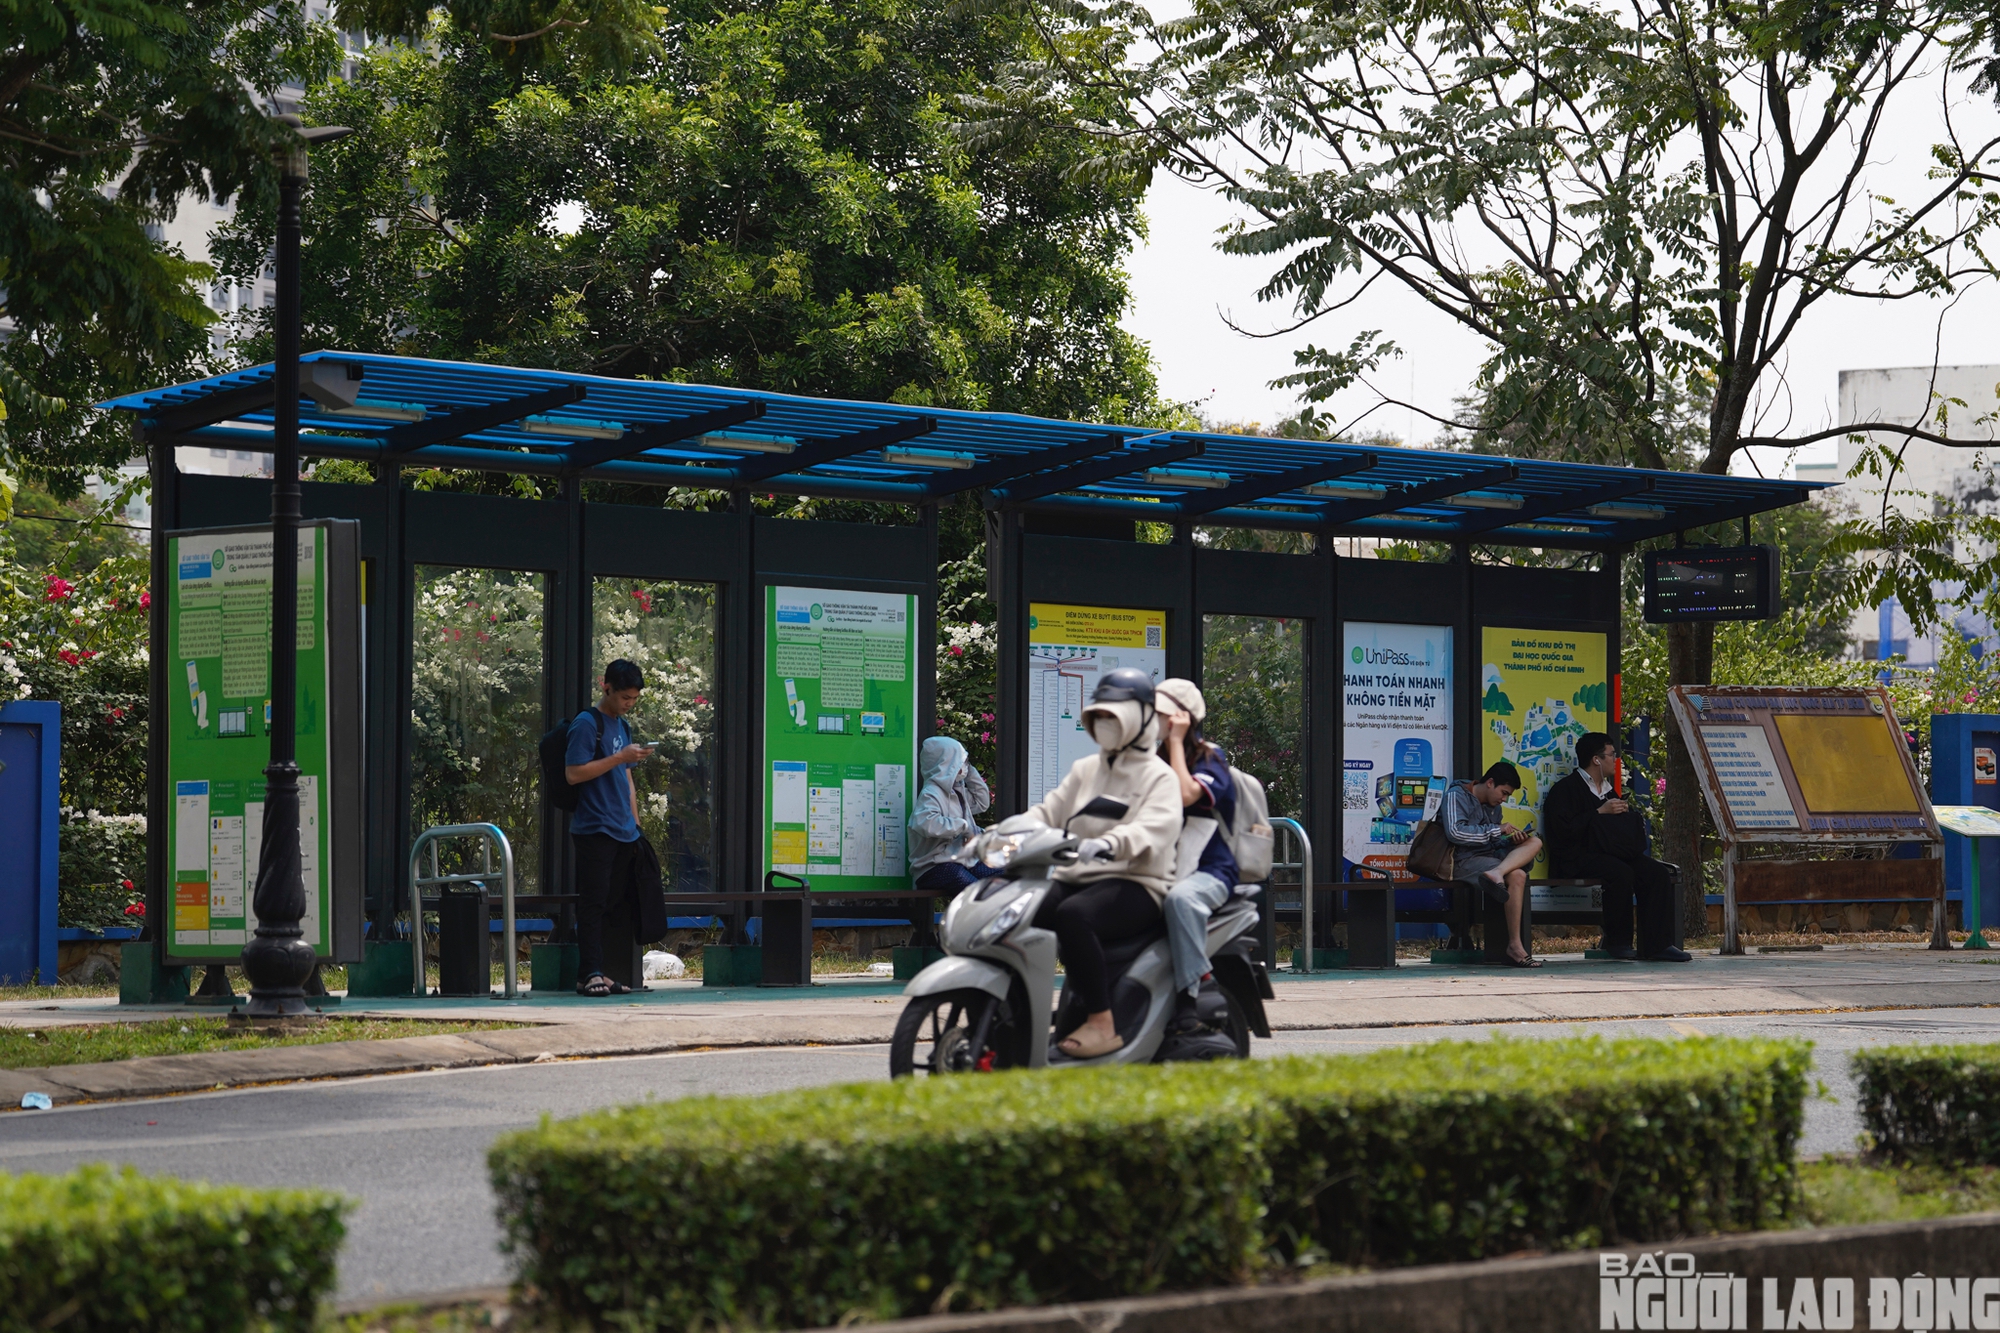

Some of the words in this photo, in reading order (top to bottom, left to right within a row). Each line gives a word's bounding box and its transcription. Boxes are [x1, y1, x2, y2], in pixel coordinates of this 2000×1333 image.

[1512, 638, 1525, 647] BẢN
[1527, 639, 1536, 648] ĐỒ
[1554, 641, 1563, 649] ĐÔ
[1366, 648, 1410, 665] UniPass
[1513, 652, 1524, 660] ĐẠI
[1541, 651, 1560, 660] QUỐC
[1504, 662, 1526, 670] THÀNH
[1528, 662, 1542, 671] PHỐ
[1543, 663, 1553, 672] HỒ
[1376, 673, 1405, 688] TOÁN
[1408, 677, 1445, 689] NHANH
[1347, 691, 1385, 706] KHÔNG
[1389, 691, 1411, 707] TIỀN
[1415, 693, 1436, 711] MẶT
[1370, 858, 1384, 867] TỔNG
